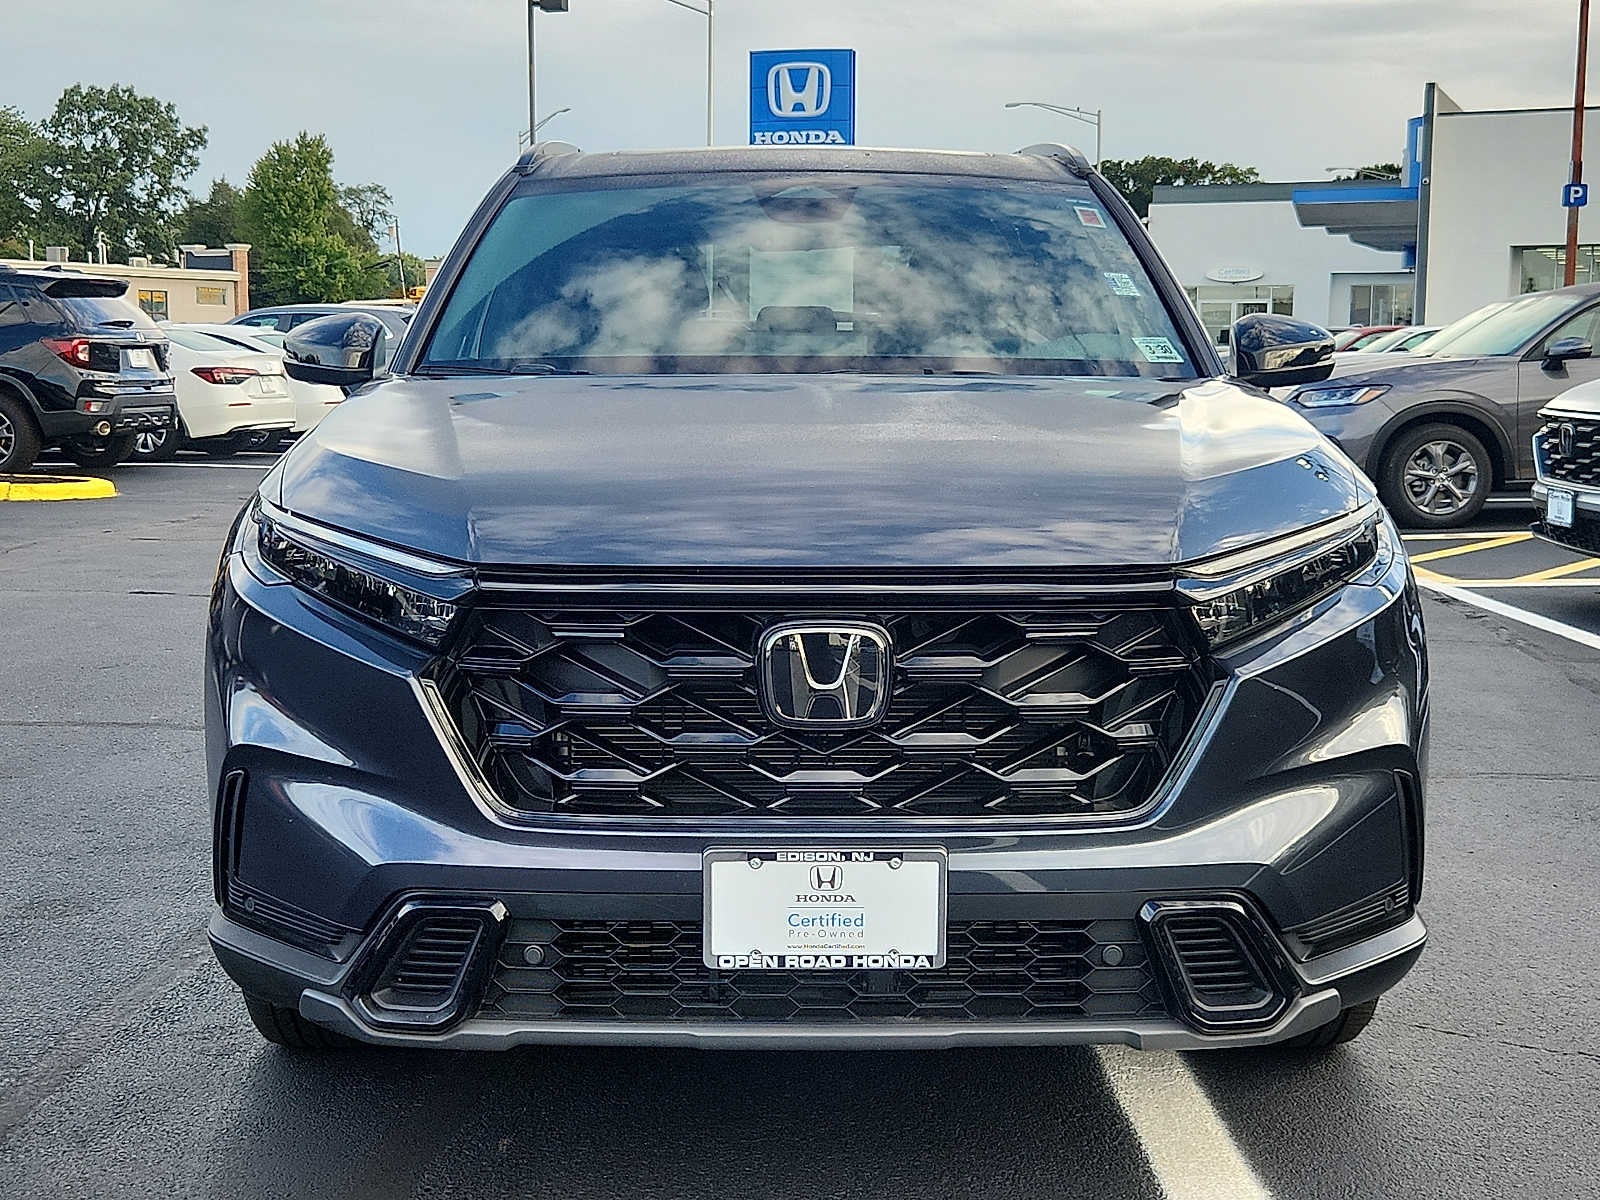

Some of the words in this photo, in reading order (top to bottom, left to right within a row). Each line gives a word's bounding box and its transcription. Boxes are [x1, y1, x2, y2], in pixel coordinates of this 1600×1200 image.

[753, 130, 845, 145] HONDA
[1570, 187, 1583, 203] P
[776, 852, 846, 861] EDISON,
[851, 852, 874, 861] NJ
[788, 912, 864, 927] Certified
[788, 929, 864, 938] Pre-Owned
[718, 955, 779, 968] OPEN
[785, 955, 847, 968] ROAD
[852, 955, 931, 968] HONDA
